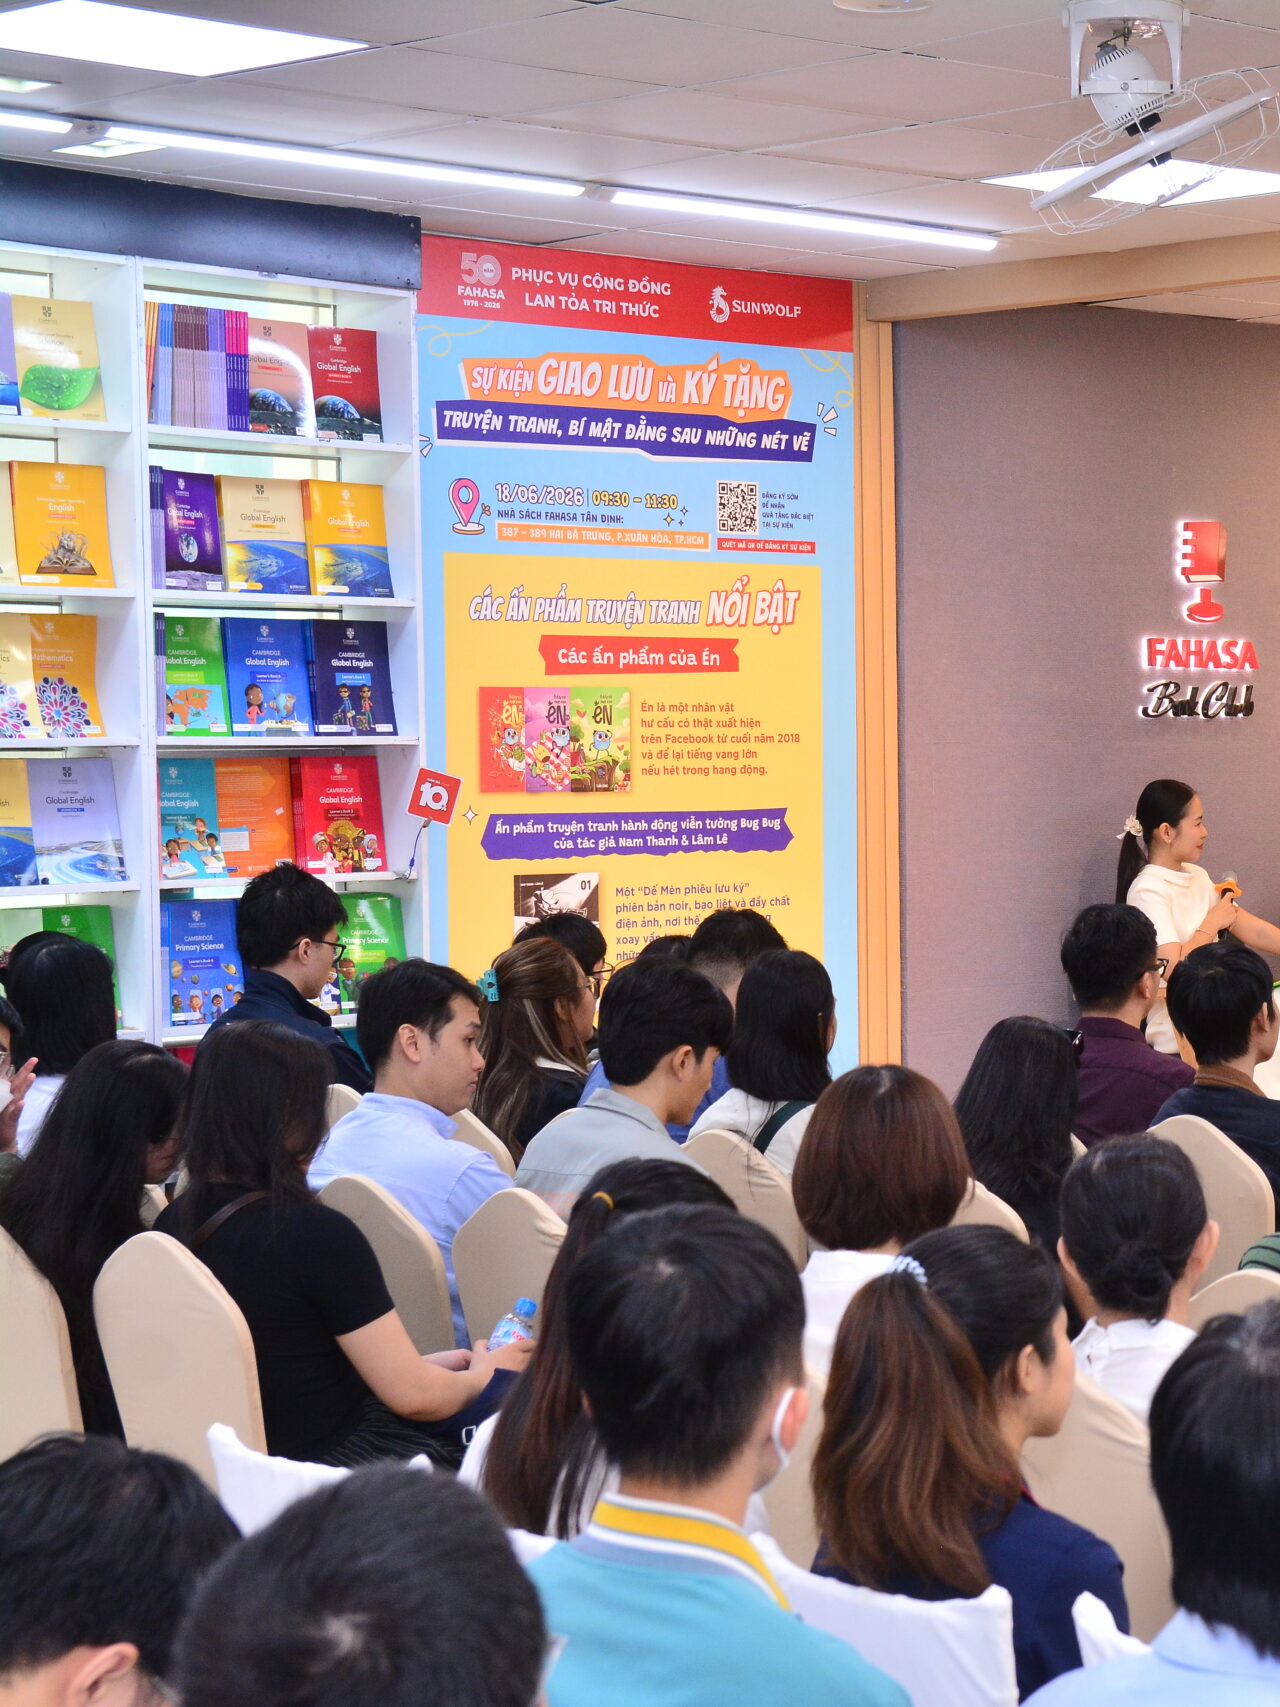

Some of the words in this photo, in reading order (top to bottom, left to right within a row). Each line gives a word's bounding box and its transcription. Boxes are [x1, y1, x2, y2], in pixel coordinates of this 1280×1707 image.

[461, 252, 501, 286] 50
[512, 268, 553, 286] PHỤC
[557, 272, 578, 289] VỤ
[583, 273, 624, 292] CỘNG
[628, 276, 671, 295] ĐỒNG
[458, 286, 505, 299] FAHASA
[525, 293, 554, 309] LAN
[559, 293, 590, 311] TỎA
[593, 300, 616, 314] TRI
[620, 301, 659, 317] THỨC
[732, 300, 801, 317] SUNWOLF
[317, 362, 337, 371] Global
[339, 362, 361, 374] English
[471, 364, 497, 395] SỰ
[497, 361, 535, 397] KIỆN
[538, 358, 602, 397] GIAO
[607, 360, 654, 401] LƯU
[658, 373, 676, 403] VÀ
[682, 357, 719, 405] KÝ
[723, 363, 786, 417] TẶNG
[444, 409, 503, 434] TRUYỆN
[509, 416, 562, 438] TRANH,
[568, 417, 587, 436] BÍ
[589, 418, 622, 442] MẬT
[671, 426, 702, 444] SAU
[705, 426, 756, 448] NHỮNG
[761, 431, 789, 450] NÉT
[793, 432, 811, 451] VẼ
[495, 483, 584, 506] 18/06/2026
[592, 491, 629, 507] 09:30
[645, 494, 678, 509] 11:30
[49, 503, 74, 512] English
[263, 514, 286, 524] English
[498, 507, 515, 518] NHÀ
[519, 509, 541, 520] SÁCH
[545, 512, 577, 521] FAHASA
[581, 511, 597, 522] TÂN
[601, 515, 624, 525] ĐỊNH:
[502, 528, 518, 536] 387
[530, 529, 546, 538] 389
[550, 529, 564, 538] HAI
[567, 528, 578, 539] BÀ
[617, 531, 648, 542] P.XUÂN
[675, 535, 704, 545] TP.HCM
[469, 584, 505, 621] CÁC
[505, 584, 532, 621] ẤN
[533, 583, 583, 622] PHẨM
[586, 591, 646, 629] TRUYỆN
[650, 600, 702, 624] TRANH
[706, 575, 751, 627] NỔI
[753, 579, 800, 635] BẬT
[558, 647, 587, 664] Các
[592, 645, 614, 664] ấn
[619, 646, 664, 669] phẩm
[669, 649, 697, 665] của
[702, 648, 720, 665] Én
[1147, 638, 1260, 669] FAHASA
[268, 658, 289, 667] English
[353, 659, 373, 668] English
[641, 700, 653, 712] Én
[657, 702, 665, 712] là
[669, 703, 688, 714] một
[692, 702, 715, 712] nhân
[719, 702, 734, 714] vật
[641, 719, 654, 728] hư
[678, 718, 689, 728] có
[693, 719, 713, 730] thật
[716, 716, 736, 728] xuất
[740, 718, 761, 730] hiện
[641, 734, 661, 743] trên
[665, 734, 714, 743] Facebook
[754, 734, 774, 743] năm
[778, 734, 800, 743] 2018
[663, 766, 679, 775] hét
[683, 767, 709, 776] trong
[713, 765, 736, 776] hang
[70, 796, 94, 805] English
[340, 796, 362, 805] English
[495, 819, 509, 834] Ấn
[513, 820, 544, 836] phẩm
[547, 821, 584, 835] truyện
[588, 821, 618, 832] tranh
[622, 820, 648, 831] hành
[651, 819, 677, 832] động
[681, 816, 702, 829] viễn
[705, 817, 737, 831] tưởng
[741, 818, 759, 830] Bug
[762, 818, 780, 830] Bug
[554, 838, 573, 849] của
[577, 837, 595, 848] tác
[599, 836, 616, 850] giả
[619, 838, 643, 847] Nam
[646, 836, 678, 846] Thanh
[692, 834, 713, 845] Lâm
[717, 834, 728, 844] Lê
[581, 880, 591, 890] 01
[616, 887, 634, 899] Một
[661, 885, 680, 895] Mèn
[685, 884, 711, 896] phiêu
[176, 944, 200, 952] Primary
